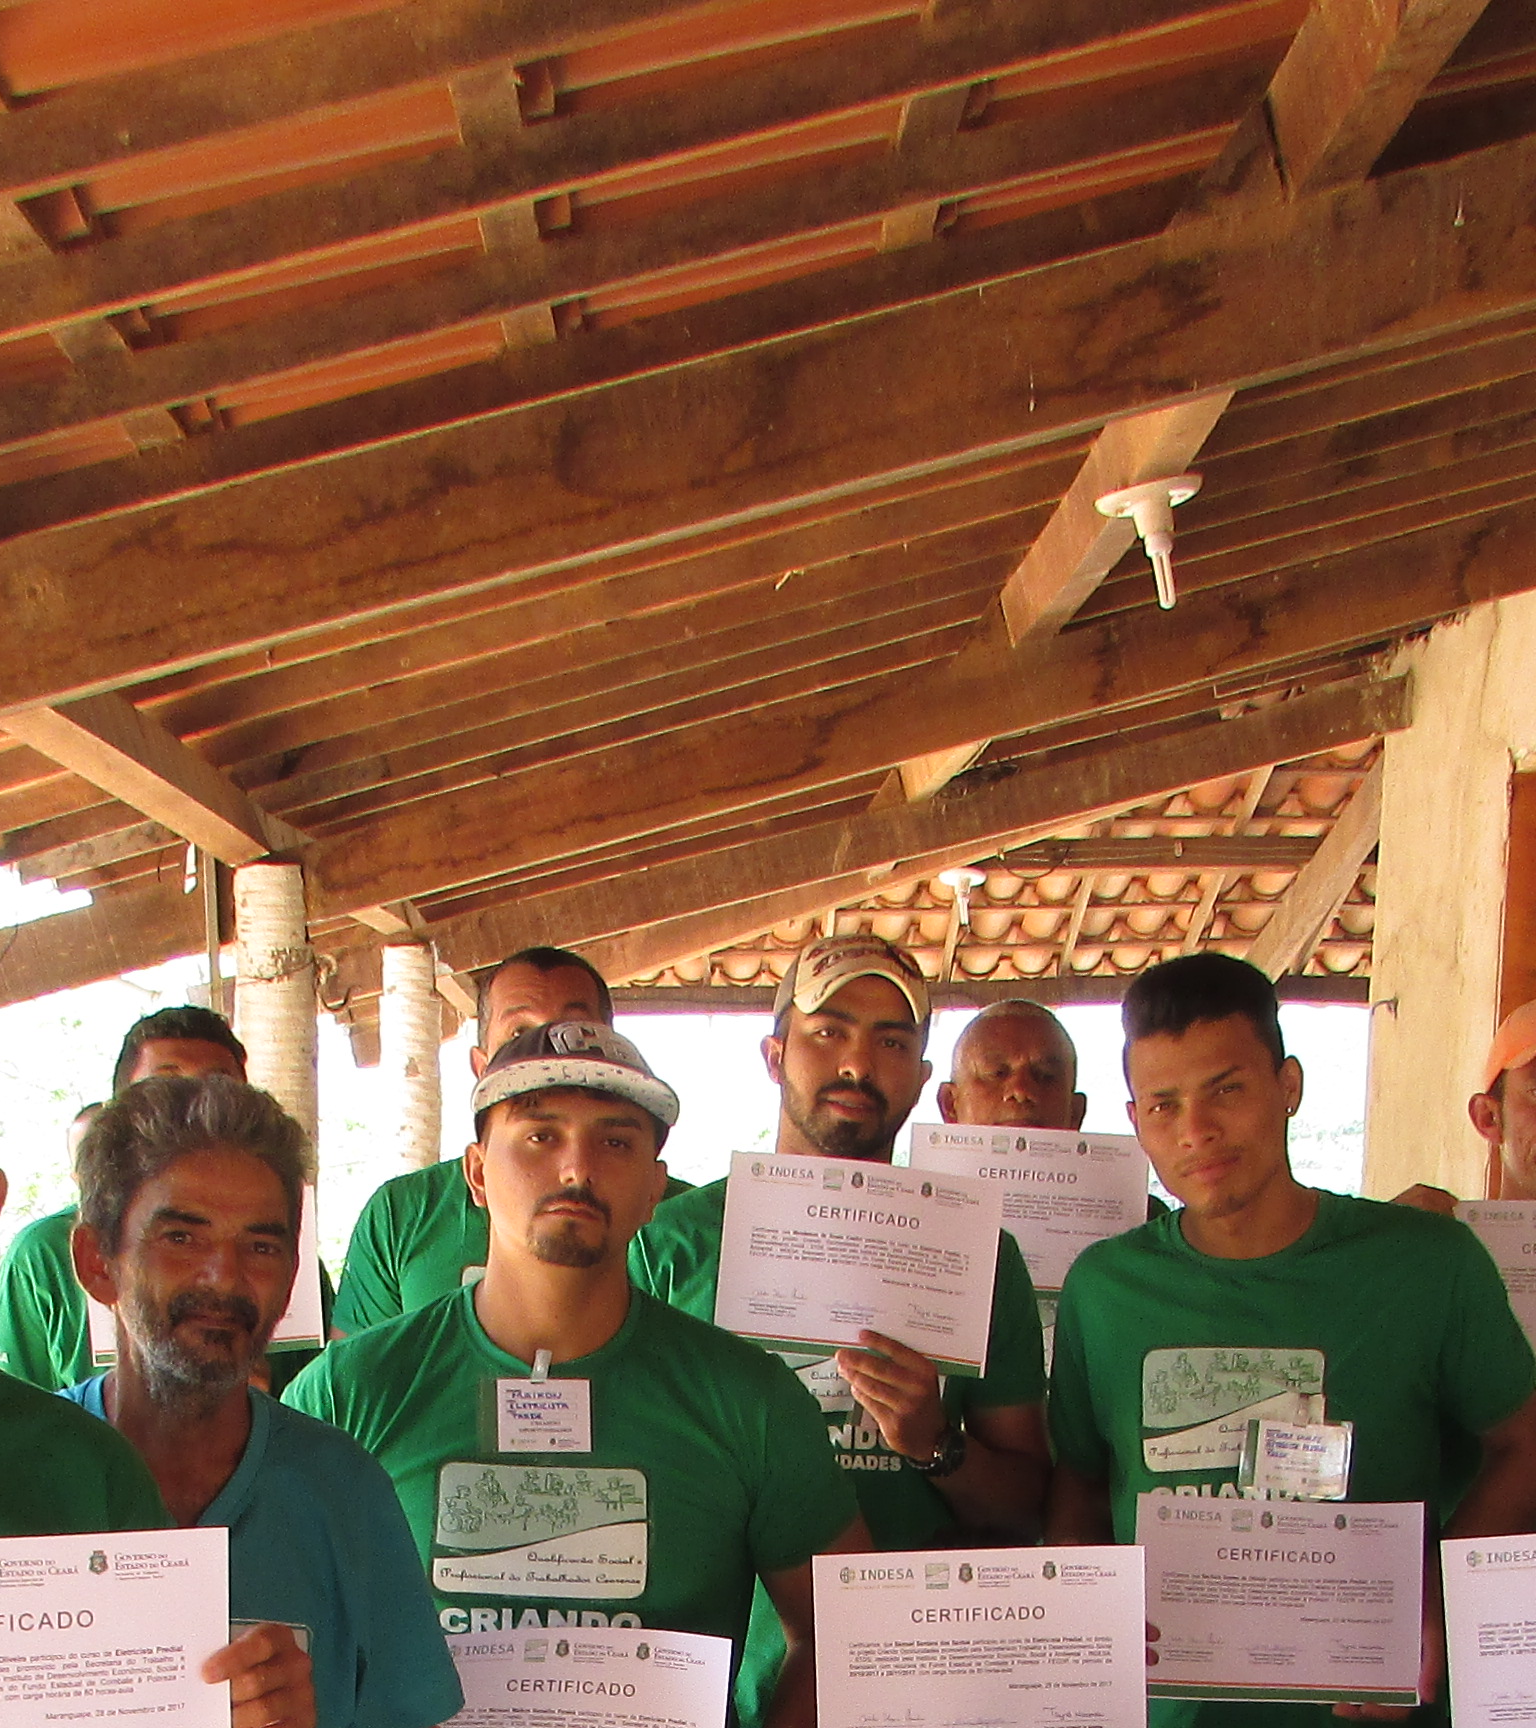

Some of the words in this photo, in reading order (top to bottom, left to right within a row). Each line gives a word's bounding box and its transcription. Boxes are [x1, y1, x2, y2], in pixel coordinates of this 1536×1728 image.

[943, 1134, 984, 1146] INDESA
[767, 1166, 815, 1180] INDESA
[978, 1166, 1078, 1184] CERTIFICADO
[806, 1204, 920, 1230] CERTIFICADO
[1174, 1509, 1222, 1522] INDESA
[1217, 1547, 1336, 1564] CERTIFICADO
[859, 1568, 914, 1581] INDESA
[911, 1605, 1046, 1623] CERTIFICADO
[465, 1643, 515, 1656] INDESA
[507, 1679, 636, 1698] CERTIFICADO
